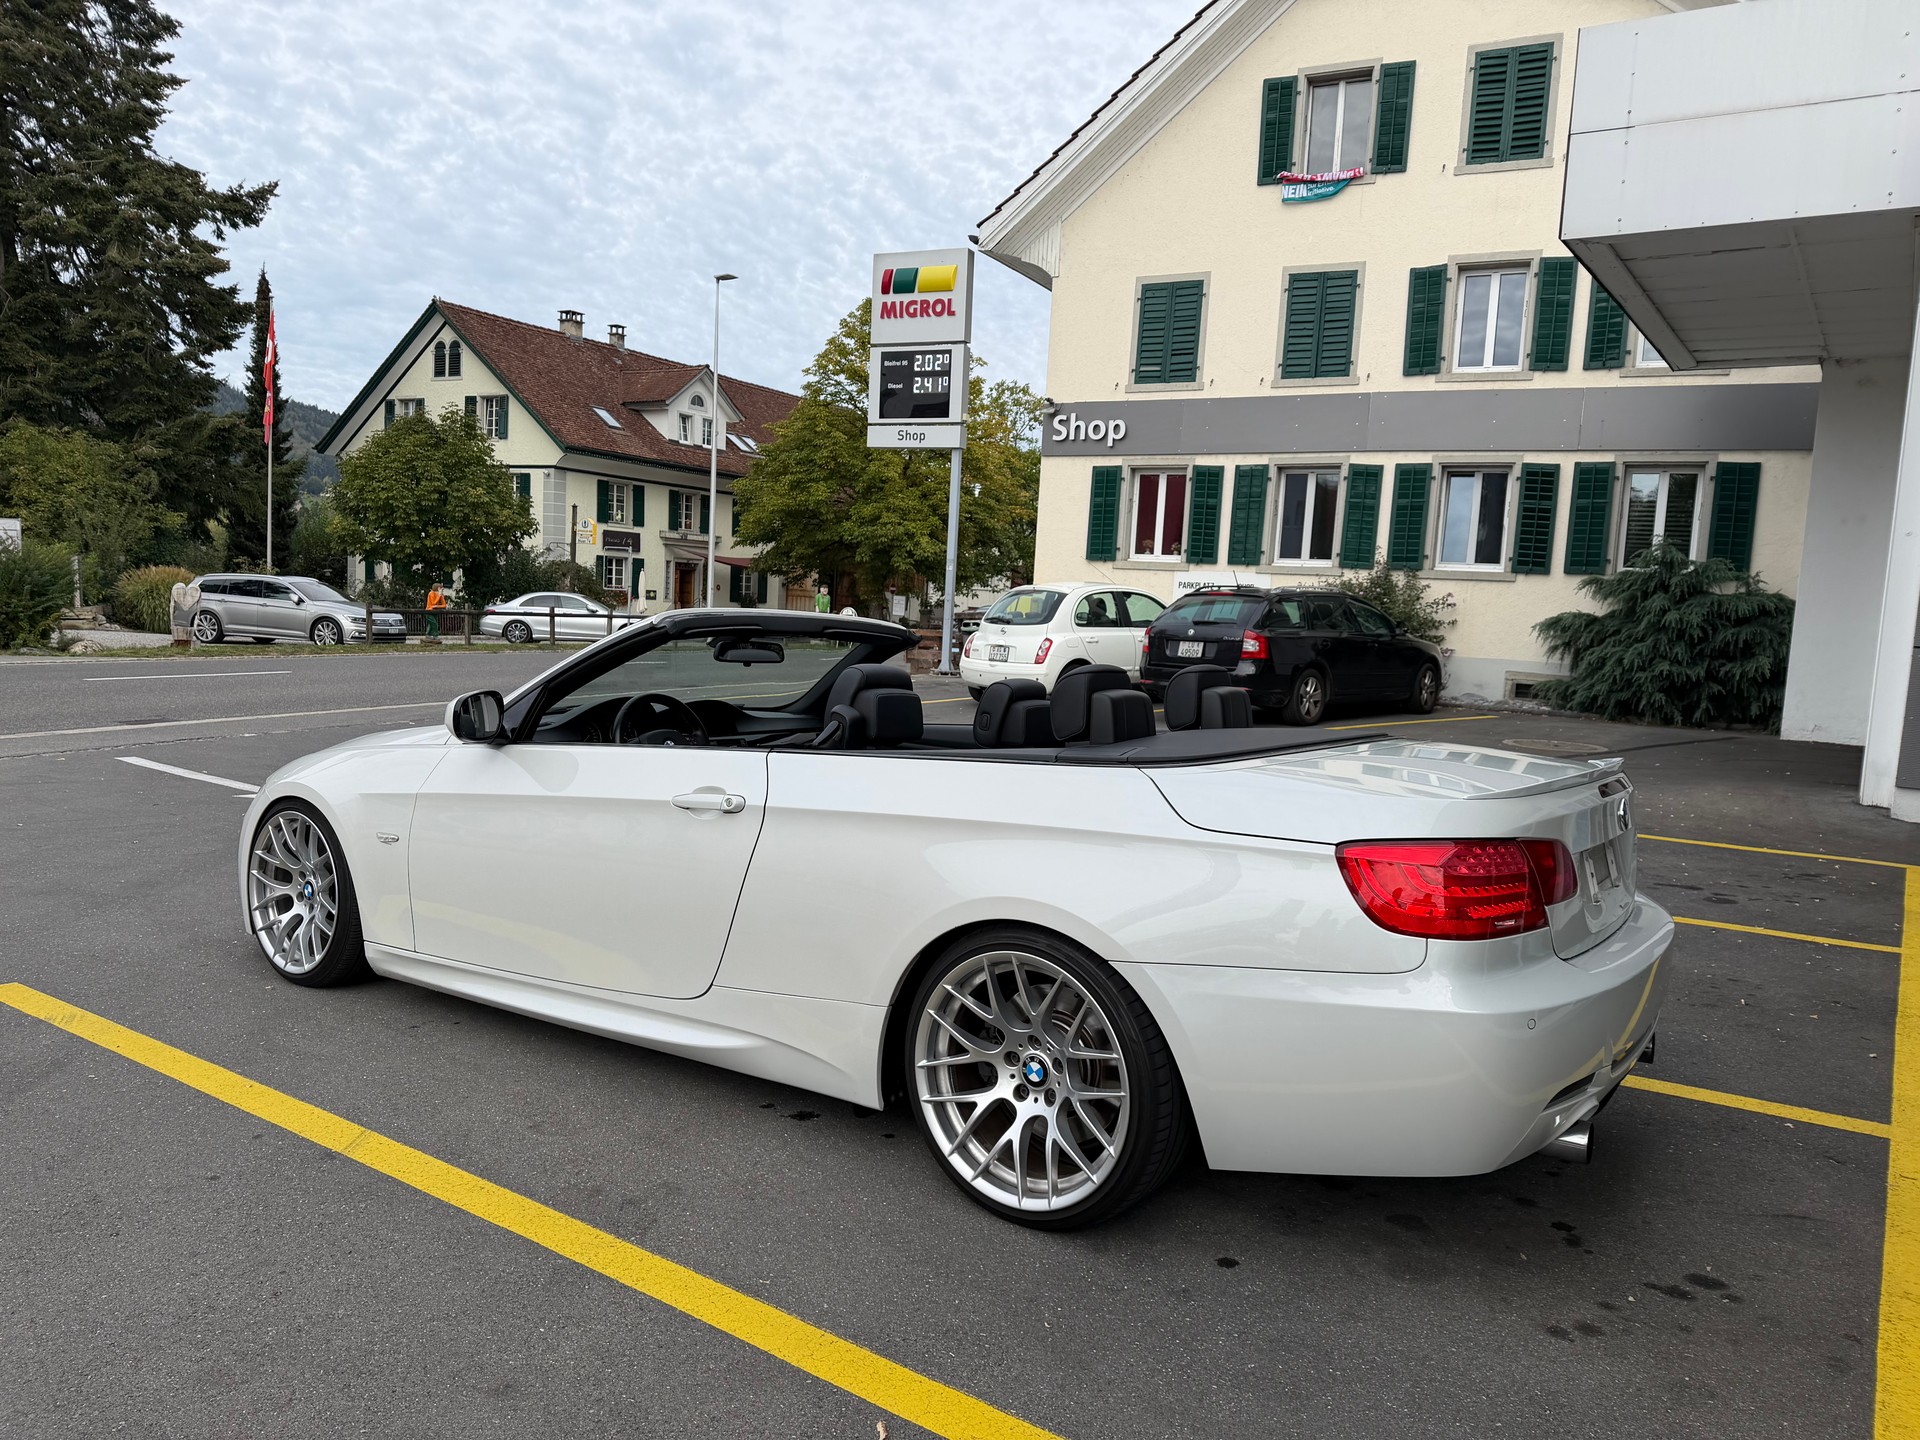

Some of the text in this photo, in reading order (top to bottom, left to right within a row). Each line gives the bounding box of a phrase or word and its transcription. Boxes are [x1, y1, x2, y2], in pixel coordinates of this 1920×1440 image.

[1282, 183, 1307, 198] NEIN
[880, 298, 956, 319] MIGROL
[897, 430, 926, 444] Shop
[1052, 413, 1126, 447] Shop
[1180, 648, 1199, 657] 49509
